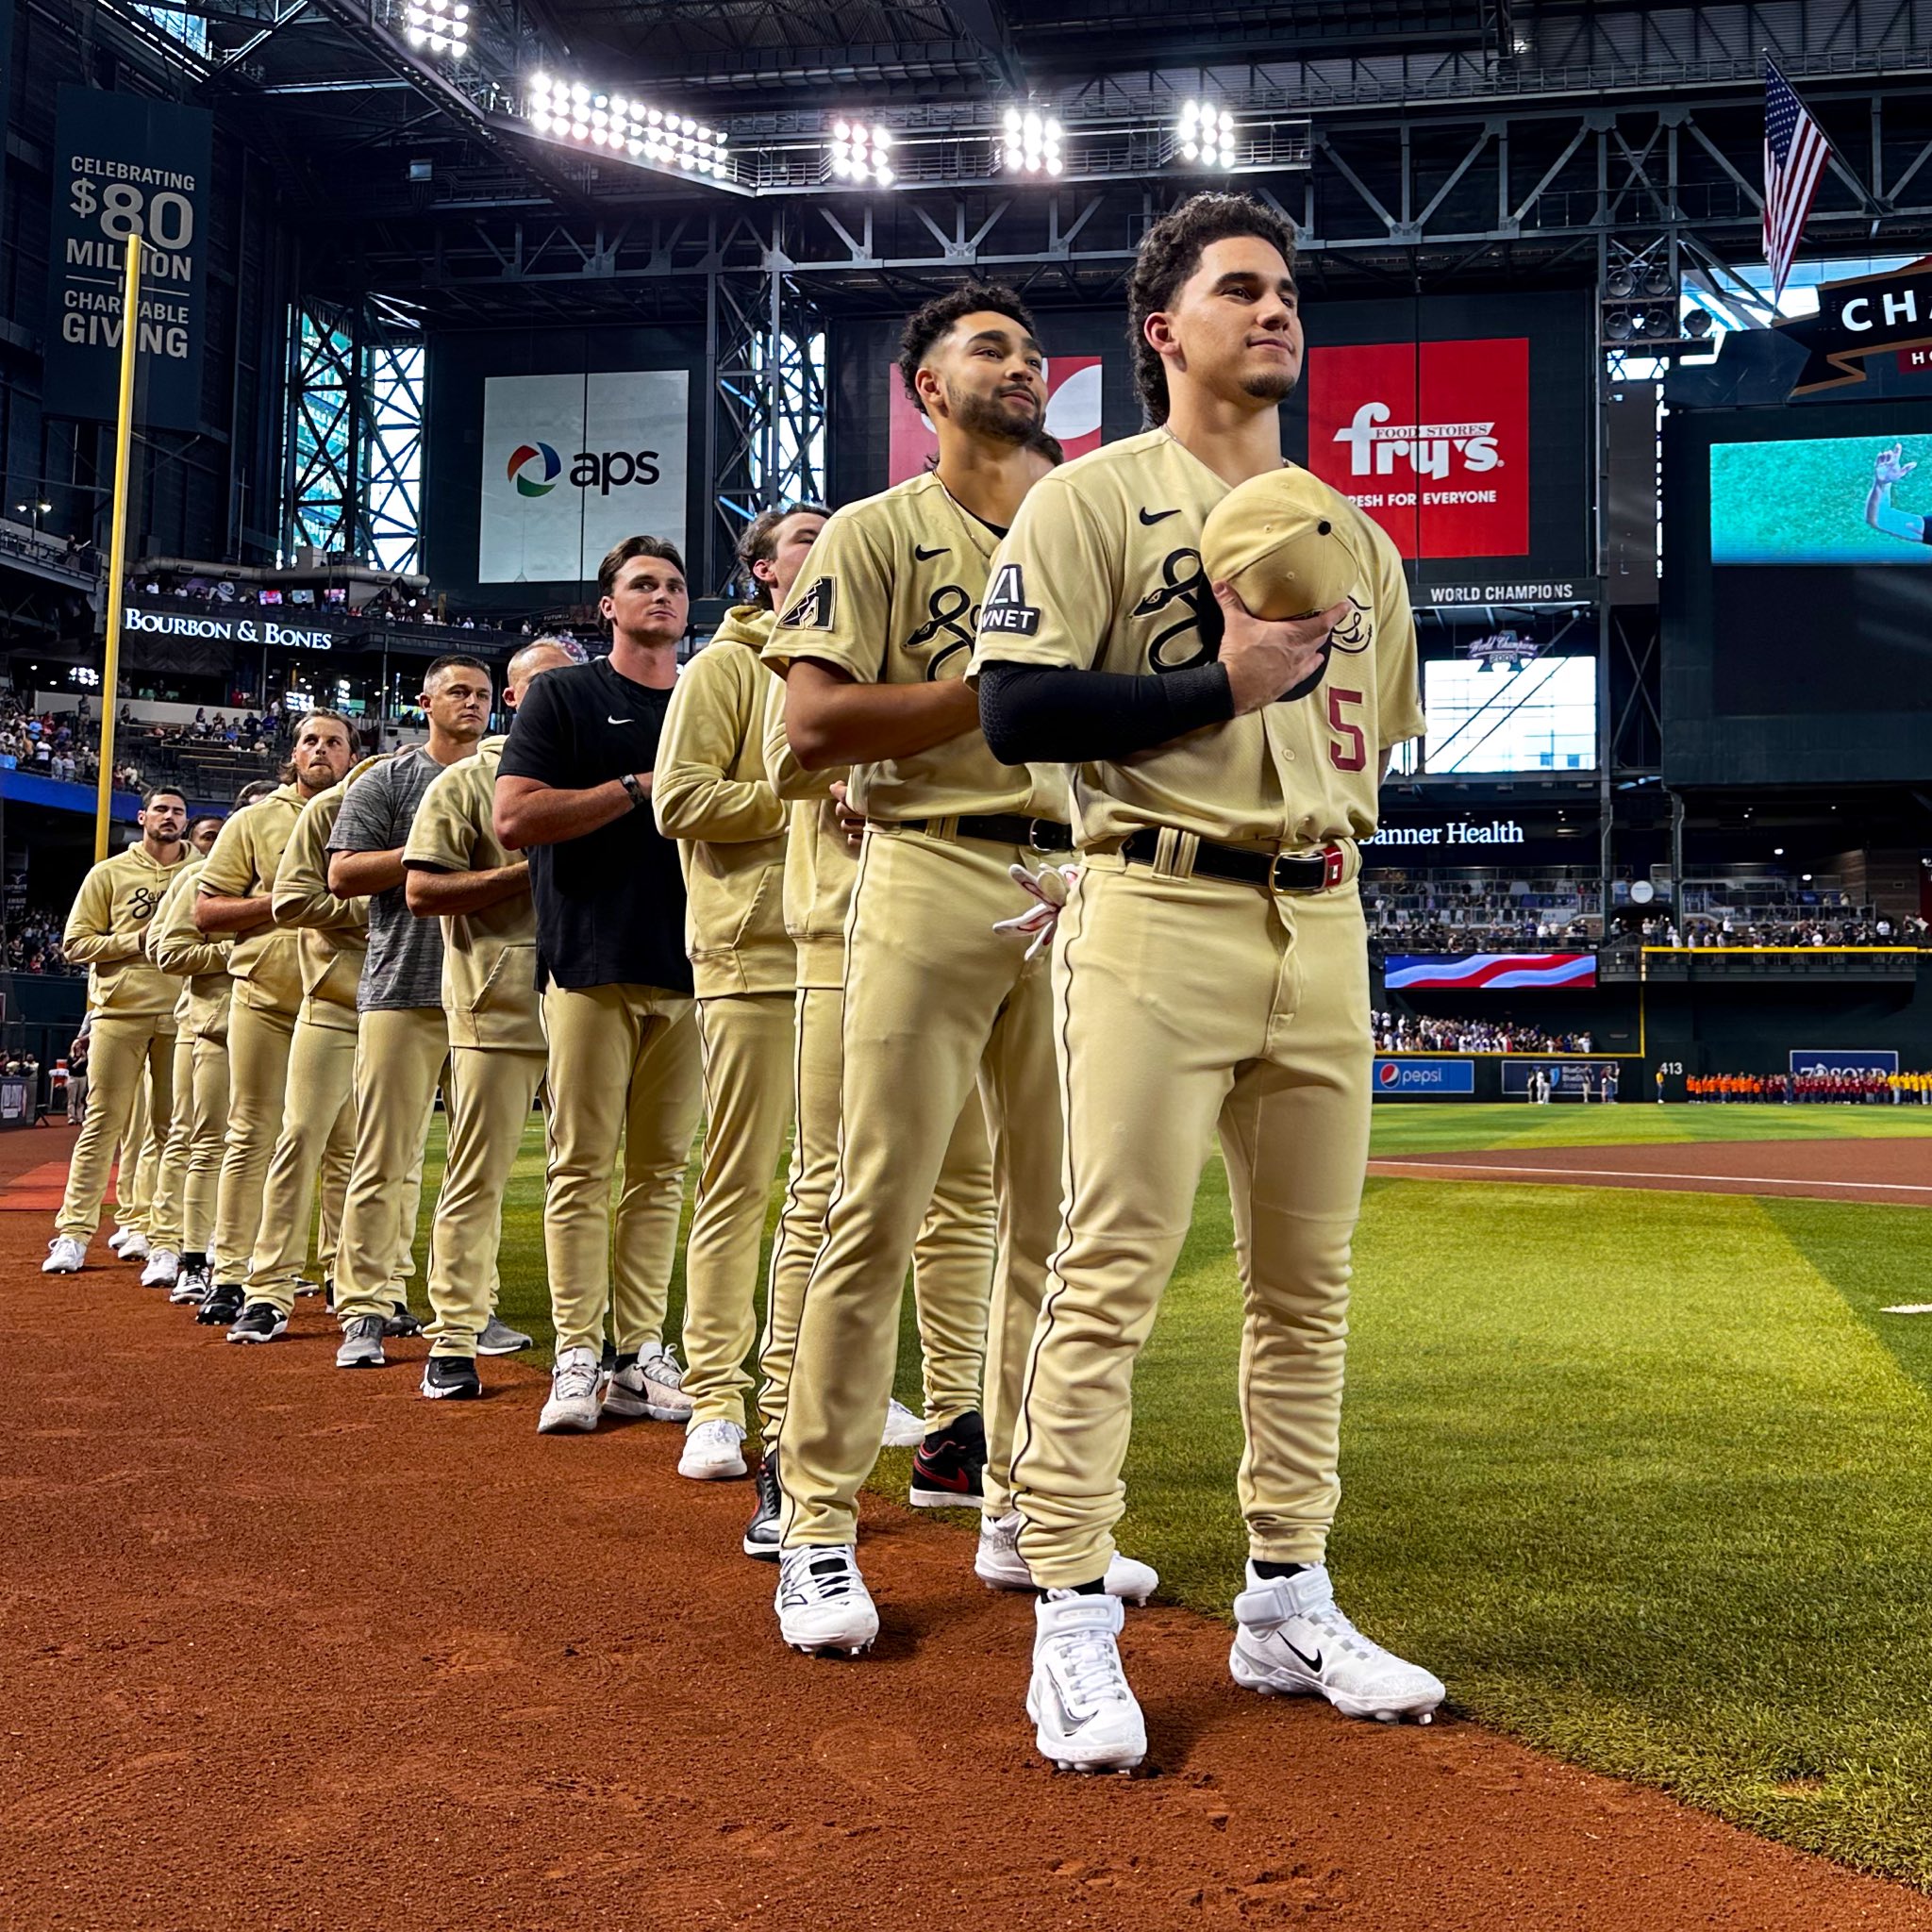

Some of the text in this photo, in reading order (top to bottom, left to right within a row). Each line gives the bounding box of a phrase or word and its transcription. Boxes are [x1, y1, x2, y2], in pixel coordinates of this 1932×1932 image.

[71, 156, 195, 192] CELEBRATING
[70, 177, 193, 250] $80
[64, 290, 190, 325] CHARABLE
[1841, 289, 1932, 332] CH
[62, 312, 188, 359] GIVNG
[1911, 351, 1932, 365] H
[1332, 401, 1499, 480] fry's
[1375, 425, 1488, 439] FOOD STORES
[570, 450, 659, 496] aps
[1347, 490, 1496, 508] RESH FOR EVERYONE
[1431, 584, 1573, 602] WORLD CHAMPIONS
[237, 620, 258, 642] &
[264, 623, 332, 650] BONES
[1327, 686, 1367, 773] 5
[1446, 821, 1524, 843] Health
[1402, 1067, 1442, 1086] pepsi
[1659, 1061, 1683, 1075] 413
